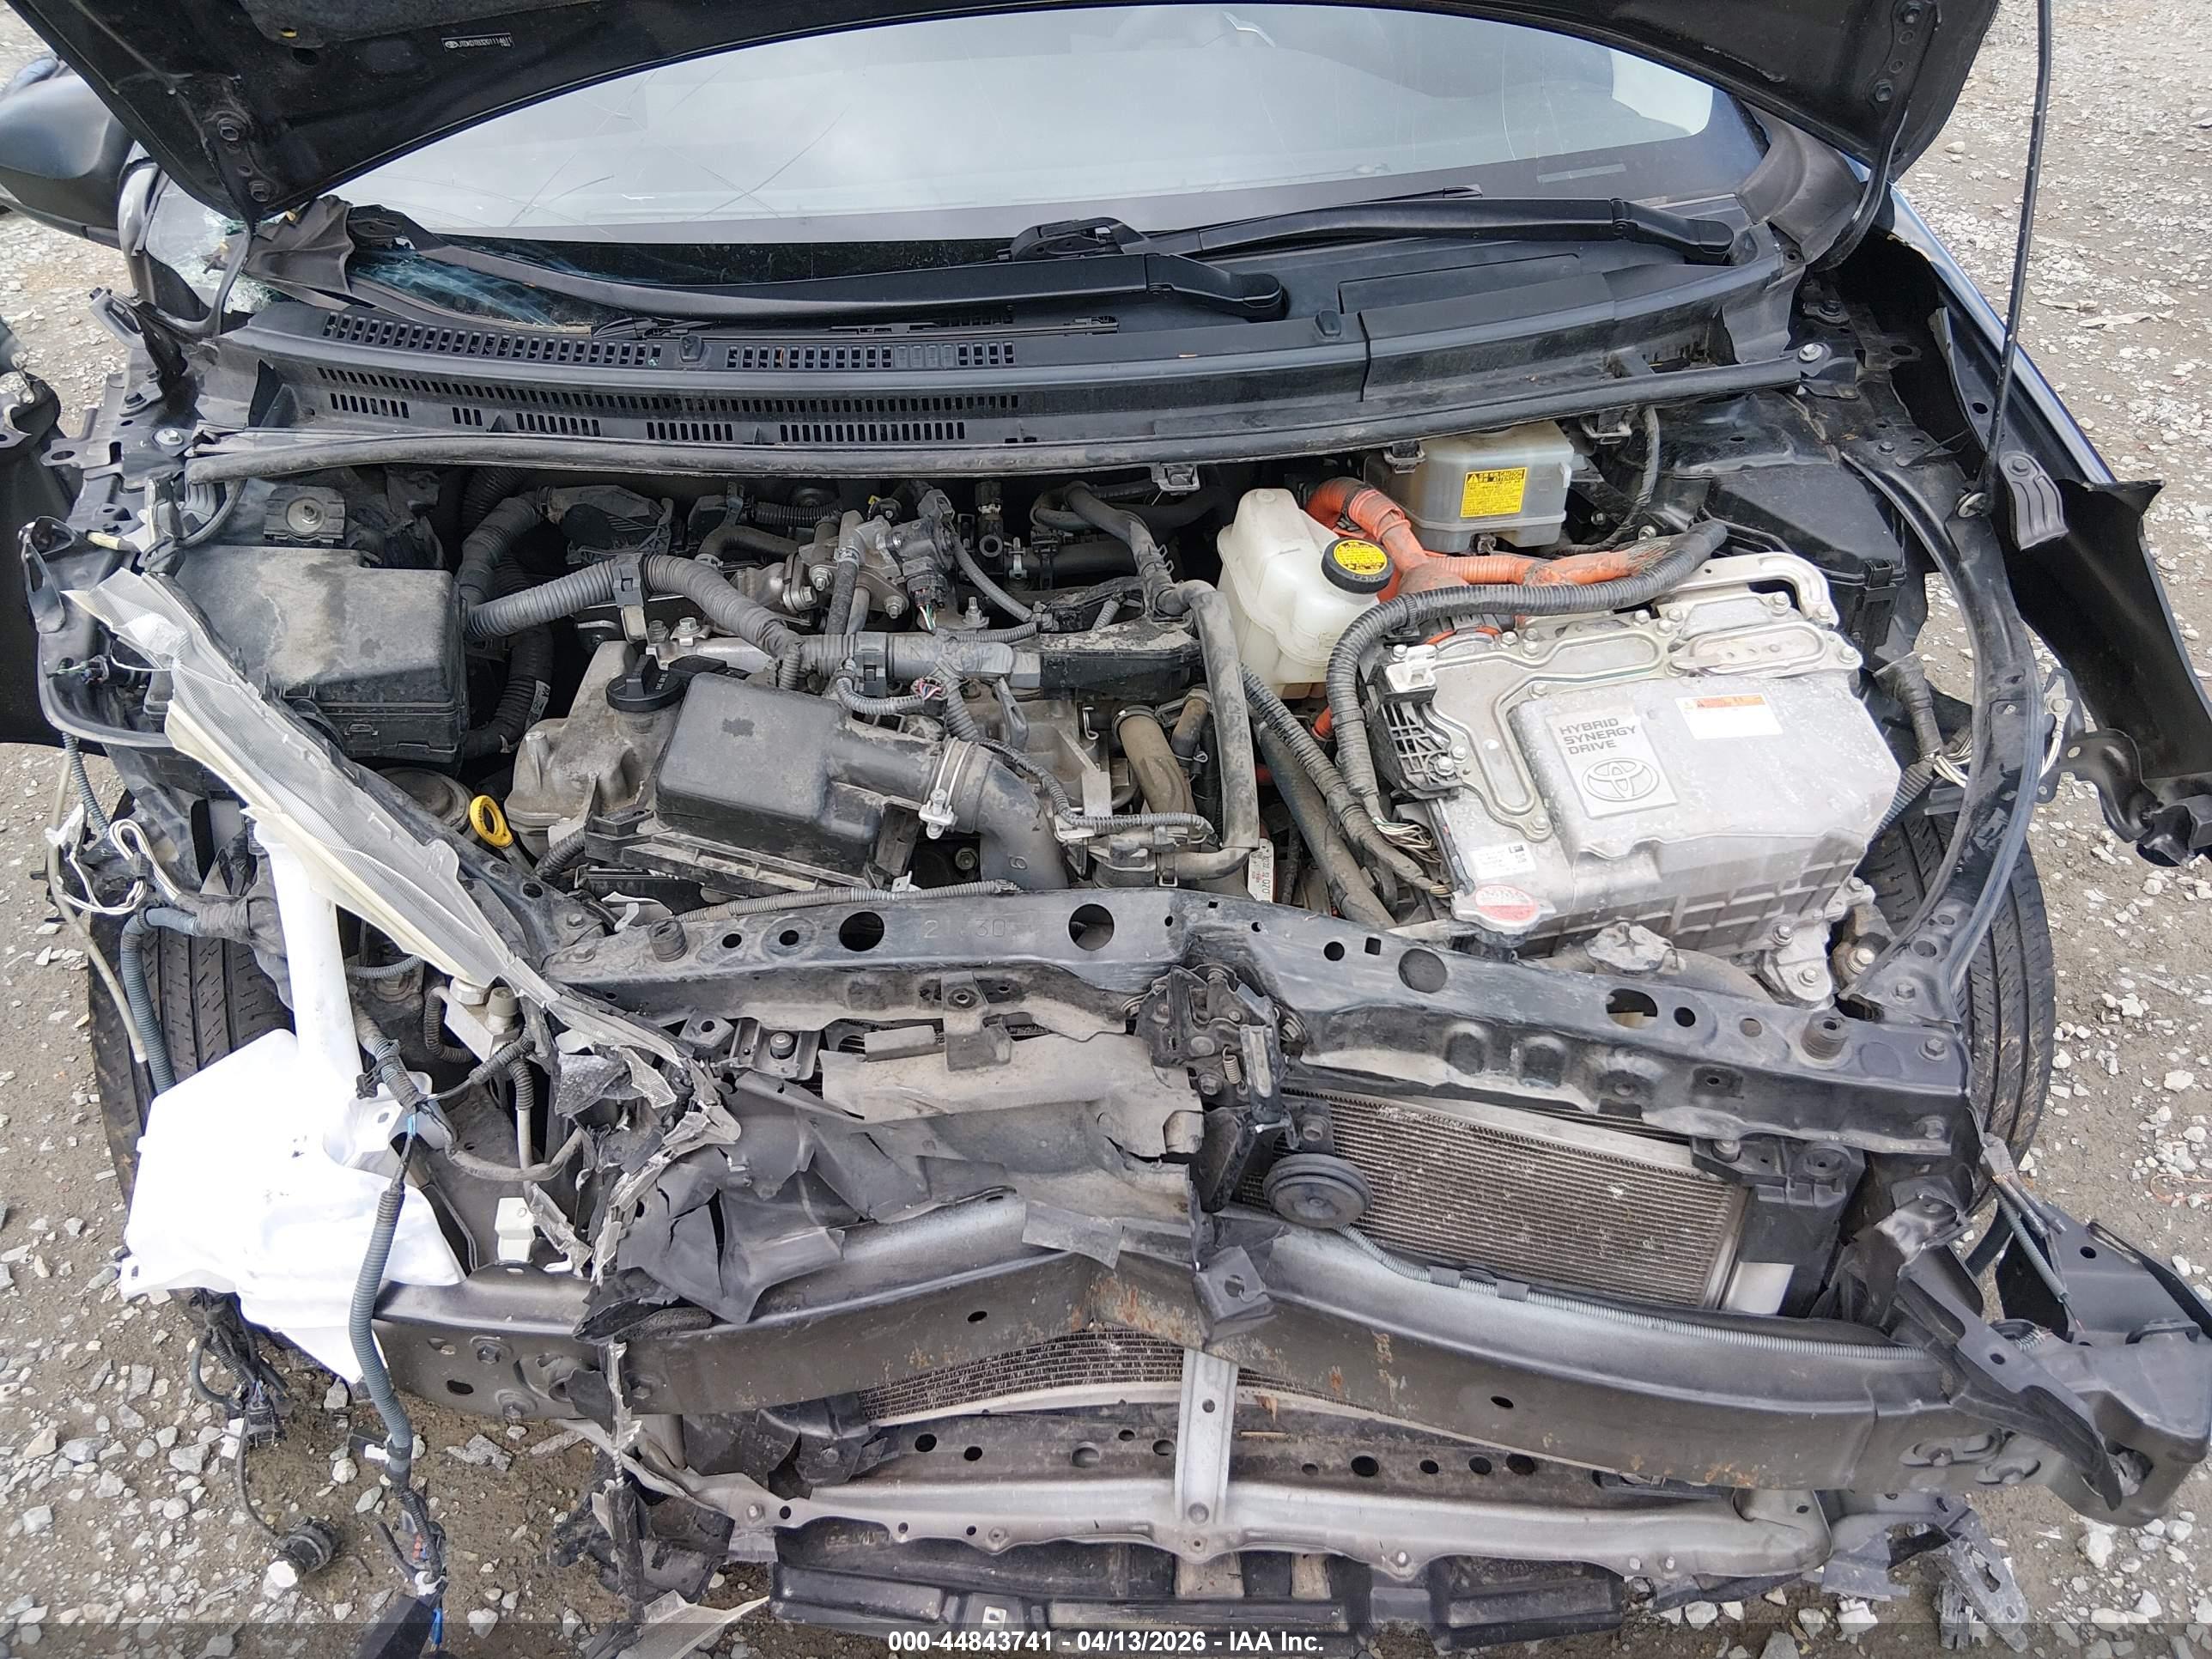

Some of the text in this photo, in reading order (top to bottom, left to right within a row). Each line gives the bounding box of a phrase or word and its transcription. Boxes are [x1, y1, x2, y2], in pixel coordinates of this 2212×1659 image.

[1559, 718, 1619, 735] HYBRID
[1564, 726, 1636, 745] SYNERGY
[1568, 739, 1617, 755] DRIVE
